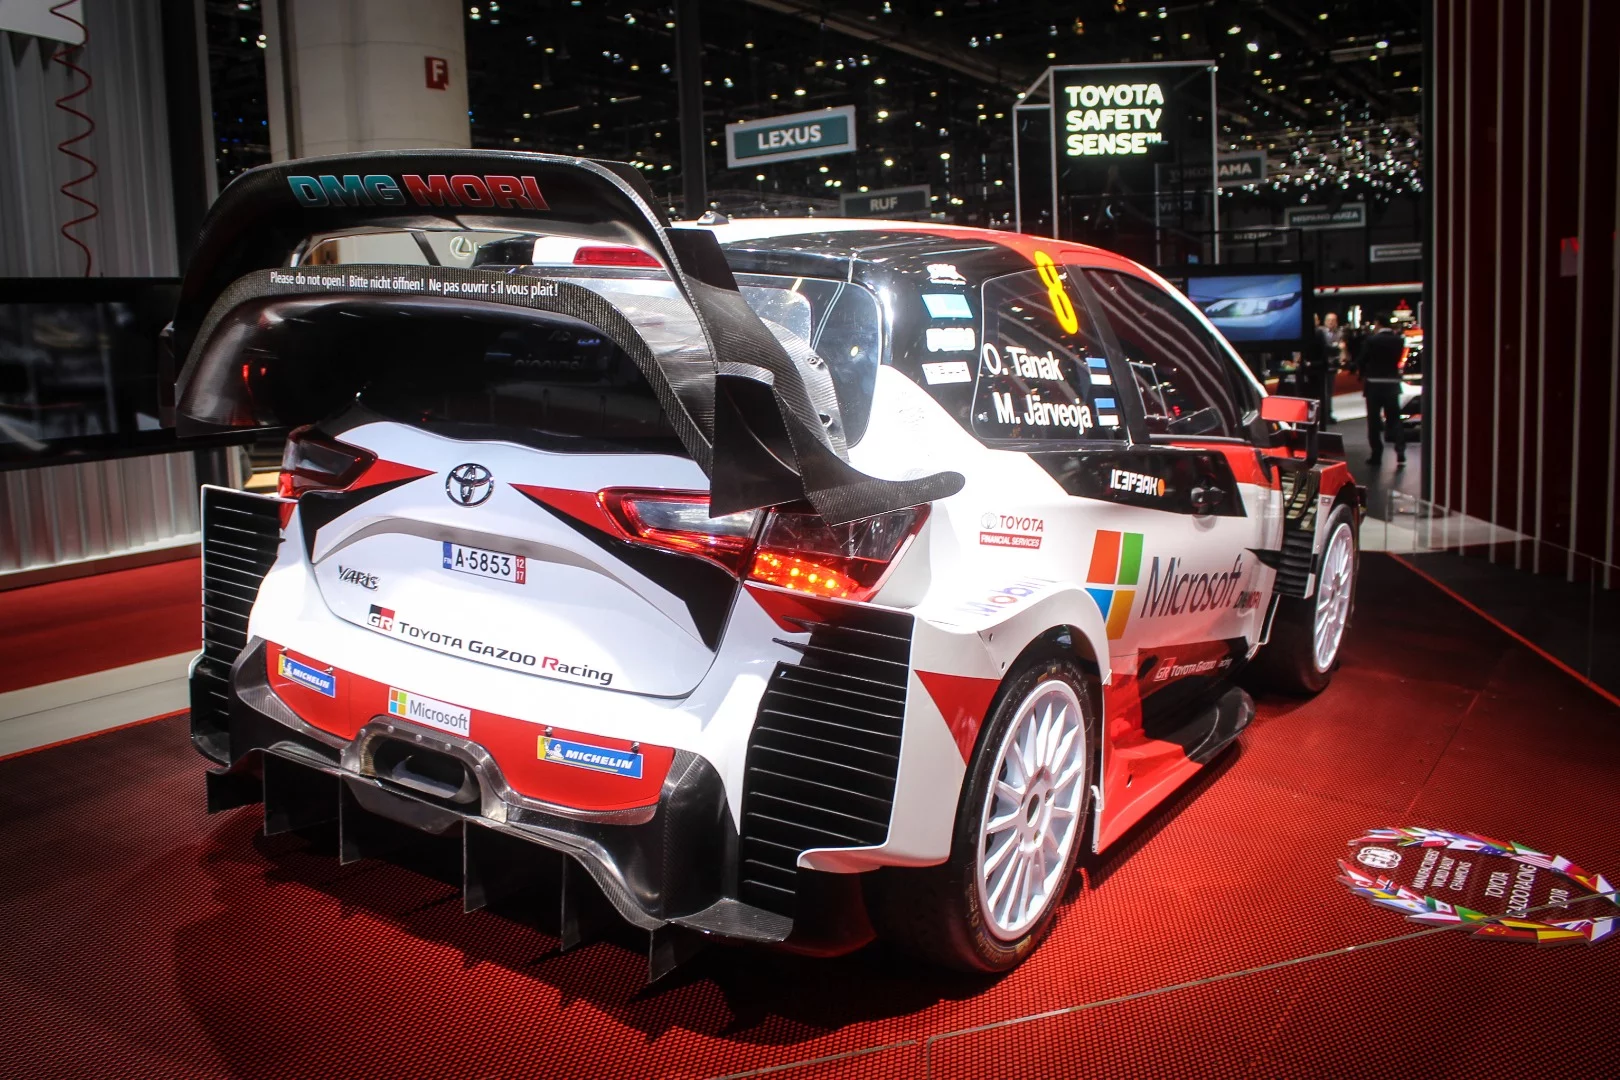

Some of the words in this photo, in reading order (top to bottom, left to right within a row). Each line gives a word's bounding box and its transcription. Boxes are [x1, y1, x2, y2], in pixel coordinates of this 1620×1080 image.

[432, 60, 444, 82] F
[1065, 84, 1164, 107] TOYOTA
[1066, 108, 1162, 132] SAFETY
[758, 124, 822, 150] LEXUS
[287, 174, 406, 207] DMG
[402, 174, 550, 211] MORI
[870, 197, 898, 211] RUF
[270, 271, 294, 285] Please
[295, 272, 306, 285] do
[307, 275, 320, 286] not
[322, 274, 345, 289] open!
[349, 275, 368, 288] Bitte
[370, 276, 391, 289] nicht
[392, 276, 424, 291] öffnen!
[429, 279, 441, 291] Ne
[444, 281, 459, 295] pas
[462, 280, 489, 294] ouvrir
[506, 284, 528, 295] vous
[1034, 250, 1079, 334] 8
[983, 343, 1008, 376] O.
[992, 391, 1021, 424] M.
[1024, 394, 1093, 435] Järveoja
[1000, 515, 1043, 532] TOYOTA
[981, 534, 1011, 546] FINANCIAL
[1011, 536, 1040, 548] SERVICES
[516, 559, 525, 569] 12
[516, 571, 525, 581] 17
[1140, 553, 1242, 618] Microsoft
[367, 611, 395, 631] GR
[399, 621, 463, 649] TOYOTA
[468, 640, 536, 666] GAZOO
[541, 656, 613, 686] Racing
[291, 667, 330, 690] MICHELIN
[410, 700, 468, 730] Microsoft
[564, 749, 633, 770] MICHELIN
[1449, 861, 1473, 891] CHAMPIONS
[1485, 871, 1510, 898] TOYOTA
[1513, 864, 1537, 891] RACING
